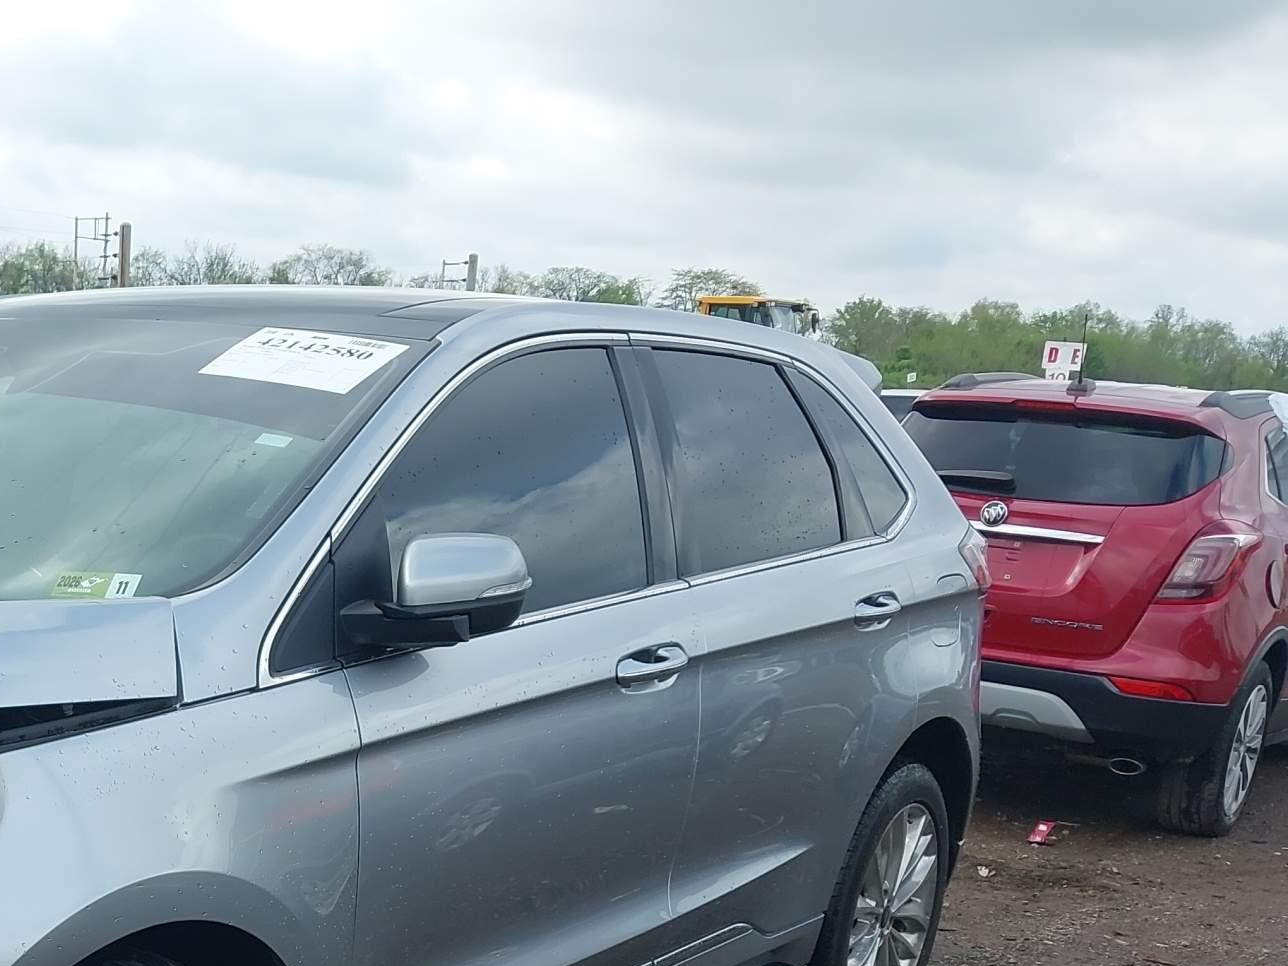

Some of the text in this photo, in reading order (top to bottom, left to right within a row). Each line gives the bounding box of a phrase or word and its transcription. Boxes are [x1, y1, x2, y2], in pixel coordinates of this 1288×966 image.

[257, 338, 374, 360] 42142580
[1047, 347, 1081, 365] D E
[56, 575, 83, 588] 2026
[115, 580, 130, 595] 11
[1031, 616, 1104, 631] ENCORE
